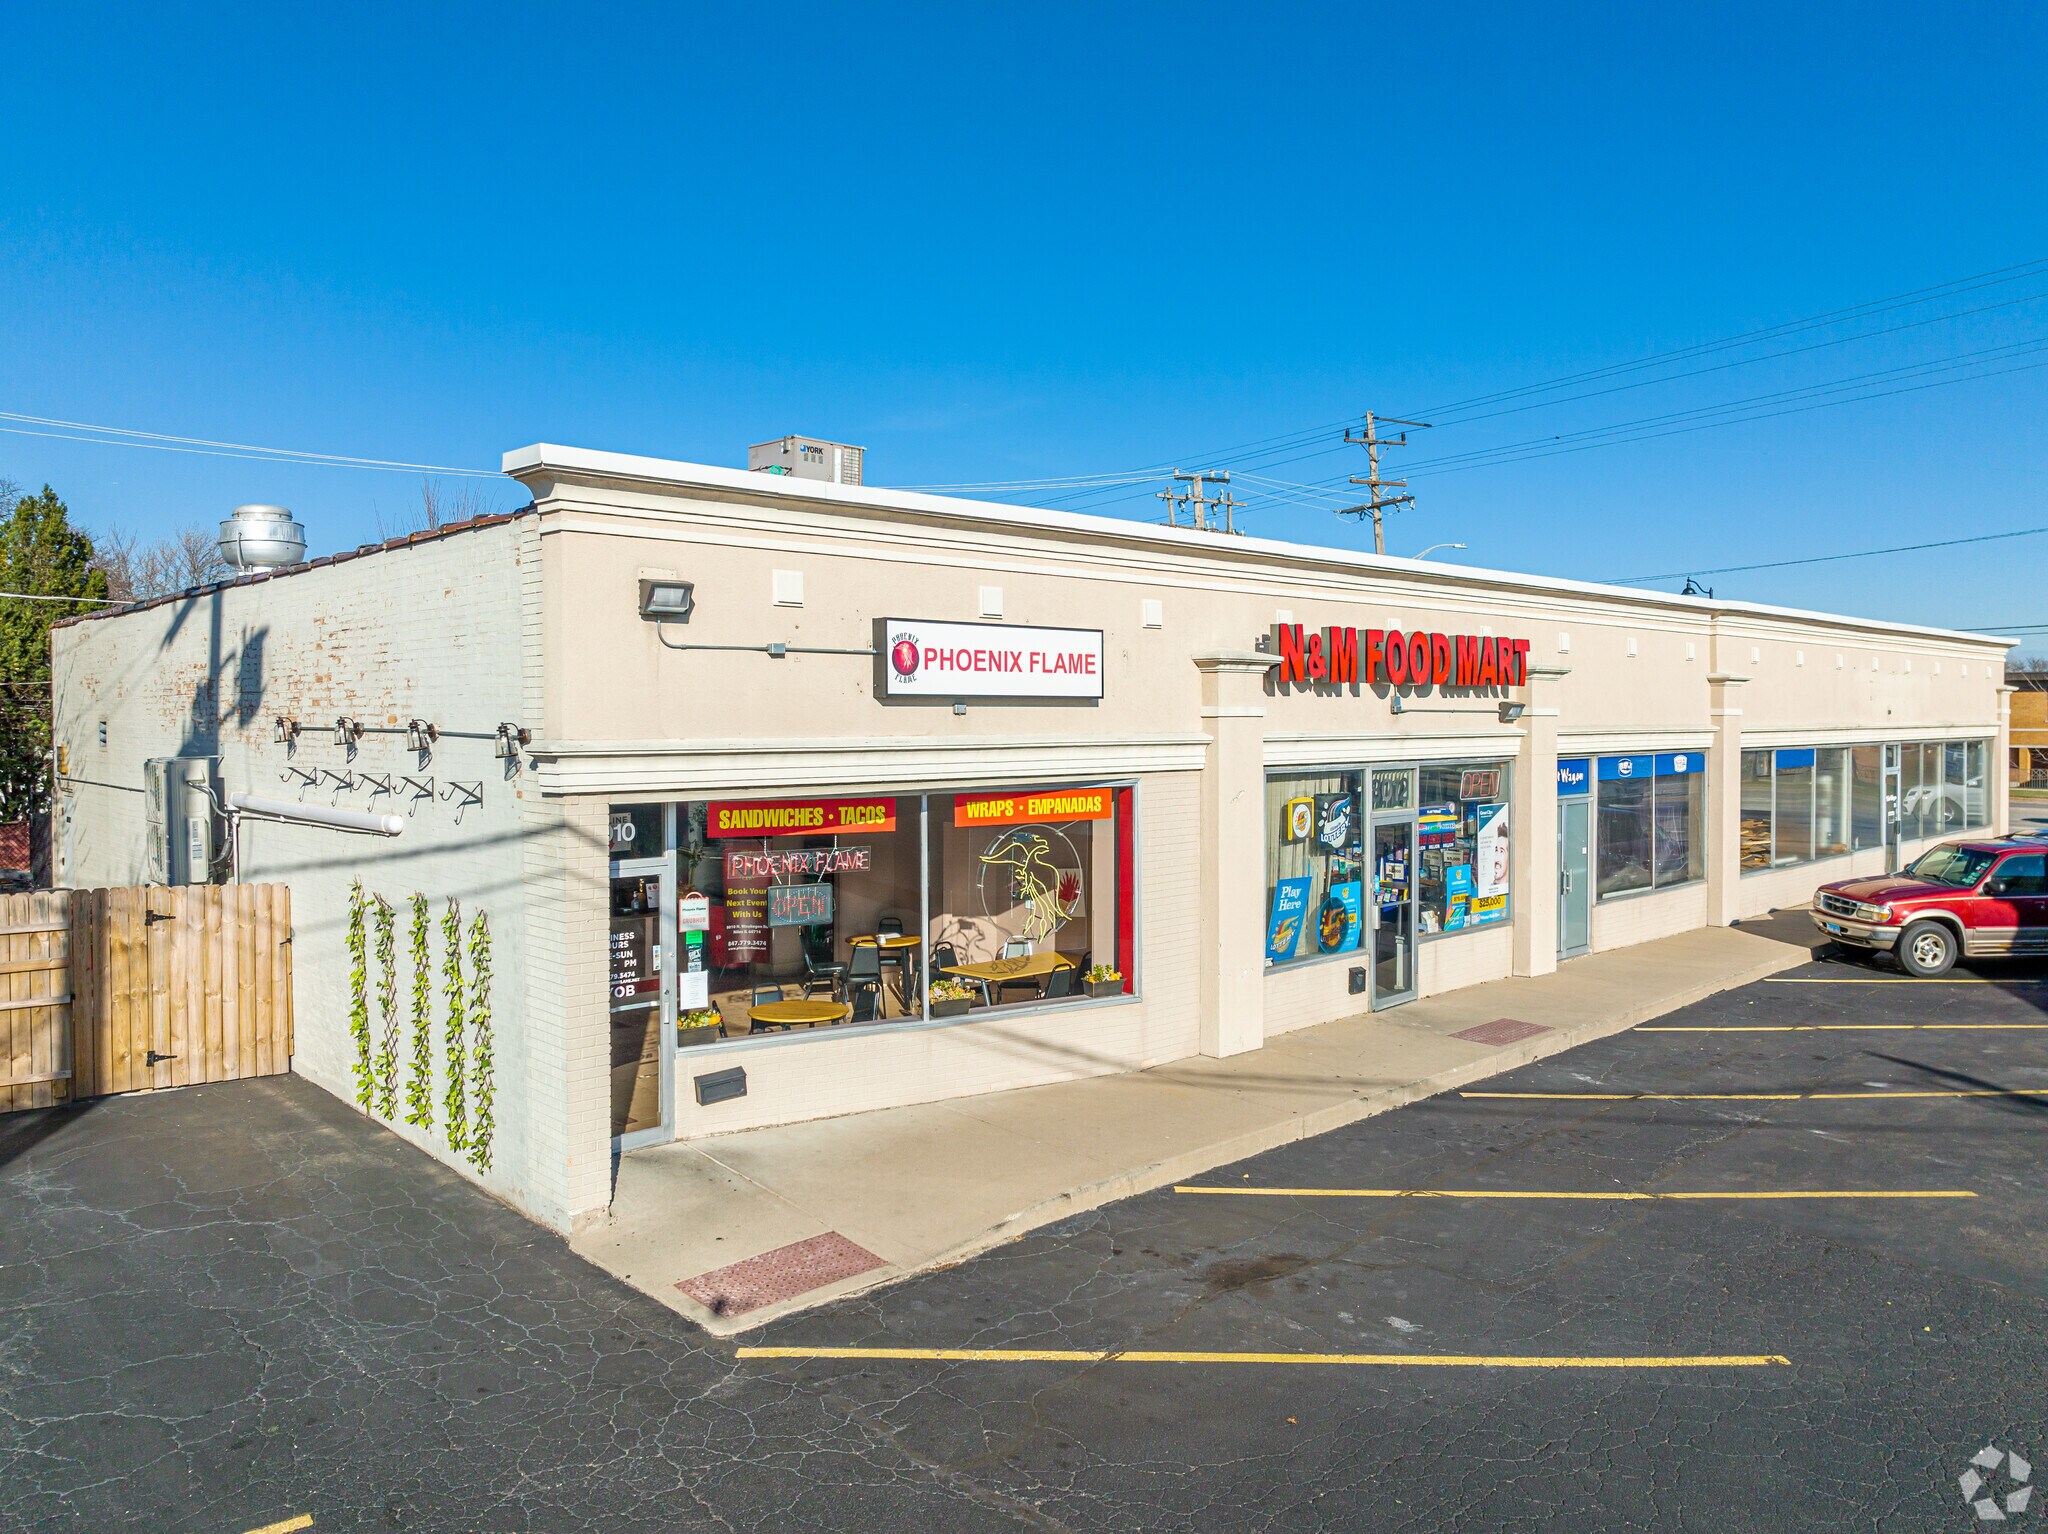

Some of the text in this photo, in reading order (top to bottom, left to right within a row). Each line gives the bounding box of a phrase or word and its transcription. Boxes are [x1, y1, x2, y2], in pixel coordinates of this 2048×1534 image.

[806, 446, 824, 455] YORK
[891, 631, 920, 645] PHOENIX
[923, 647, 1097, 675] PHOENIX FLAME
[1271, 623, 1531, 687] N&M FOOD MART
[894, 673, 918, 684] FLAME
[1464, 771, 1500, 797] OPEN
[1560, 767, 1584, 785] Wagon
[966, 795, 1102, 819] WRAPS EMPANADAS
[718, 805, 886, 830] SANDWICHES TACOS
[1320, 815, 1351, 843] LOTTERY
[731, 850, 870, 877] PHOENIX FLAME
[727, 887, 768, 896] Book Your
[1280, 885, 1302, 899] Play
[726, 899, 745, 907] Next
[772, 896, 825, 917] OPEN
[1278, 898, 1302, 912] Here
[624, 959, 637, 968] PM
